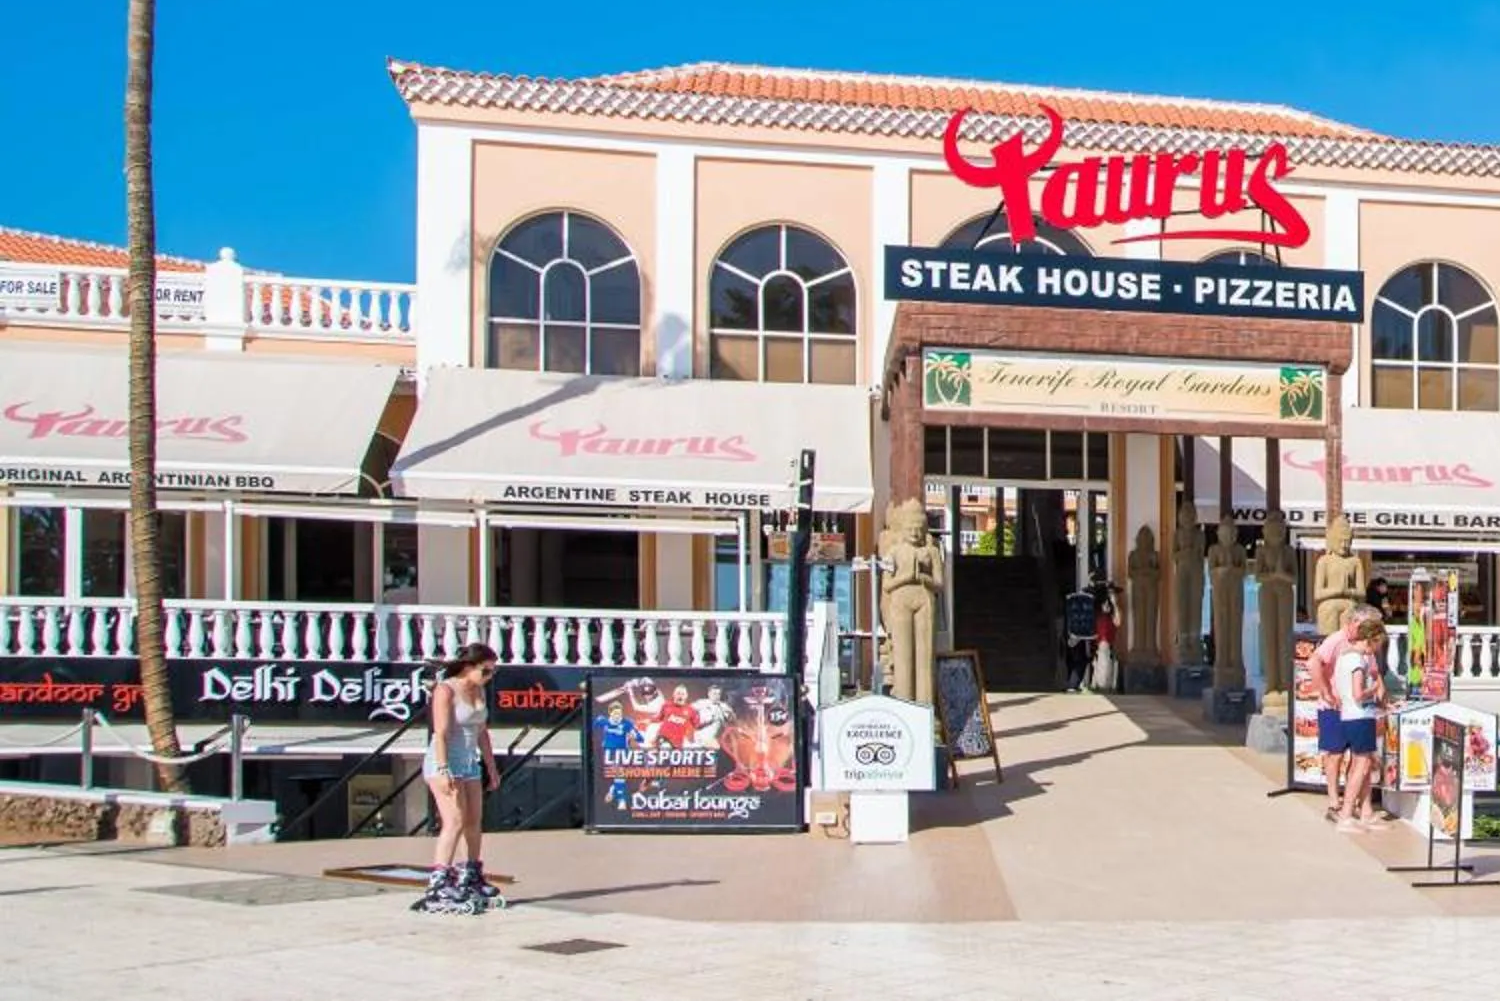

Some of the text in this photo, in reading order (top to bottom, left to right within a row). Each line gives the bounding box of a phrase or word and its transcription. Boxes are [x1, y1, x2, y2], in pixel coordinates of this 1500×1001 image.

[943, 103, 1311, 248] Taurus
[0, 280, 57, 295] FOR SALE
[156, 289, 205, 303] OR RENT
[900, 258, 1357, 313] STEAK HOUSE PIZZERIA
[978, 361, 1272, 397] Tenerife Royal Gardens
[529, 419, 757, 462] Taurus
[97, 470, 230, 488] ARNTINIAN
[235, 475, 275, 488] BBQ
[503, 485, 771, 507] ARGENTINE STEAK HOUSE
[1231, 508, 1304, 522] WOD
[1375, 512, 1445, 527] GRILL
[0, 672, 105, 702] andoor
[199, 663, 300, 701] Delhi
[604, 749, 717, 766] LIVE SPORTS
[631, 789, 761, 819] Dubai lounge
